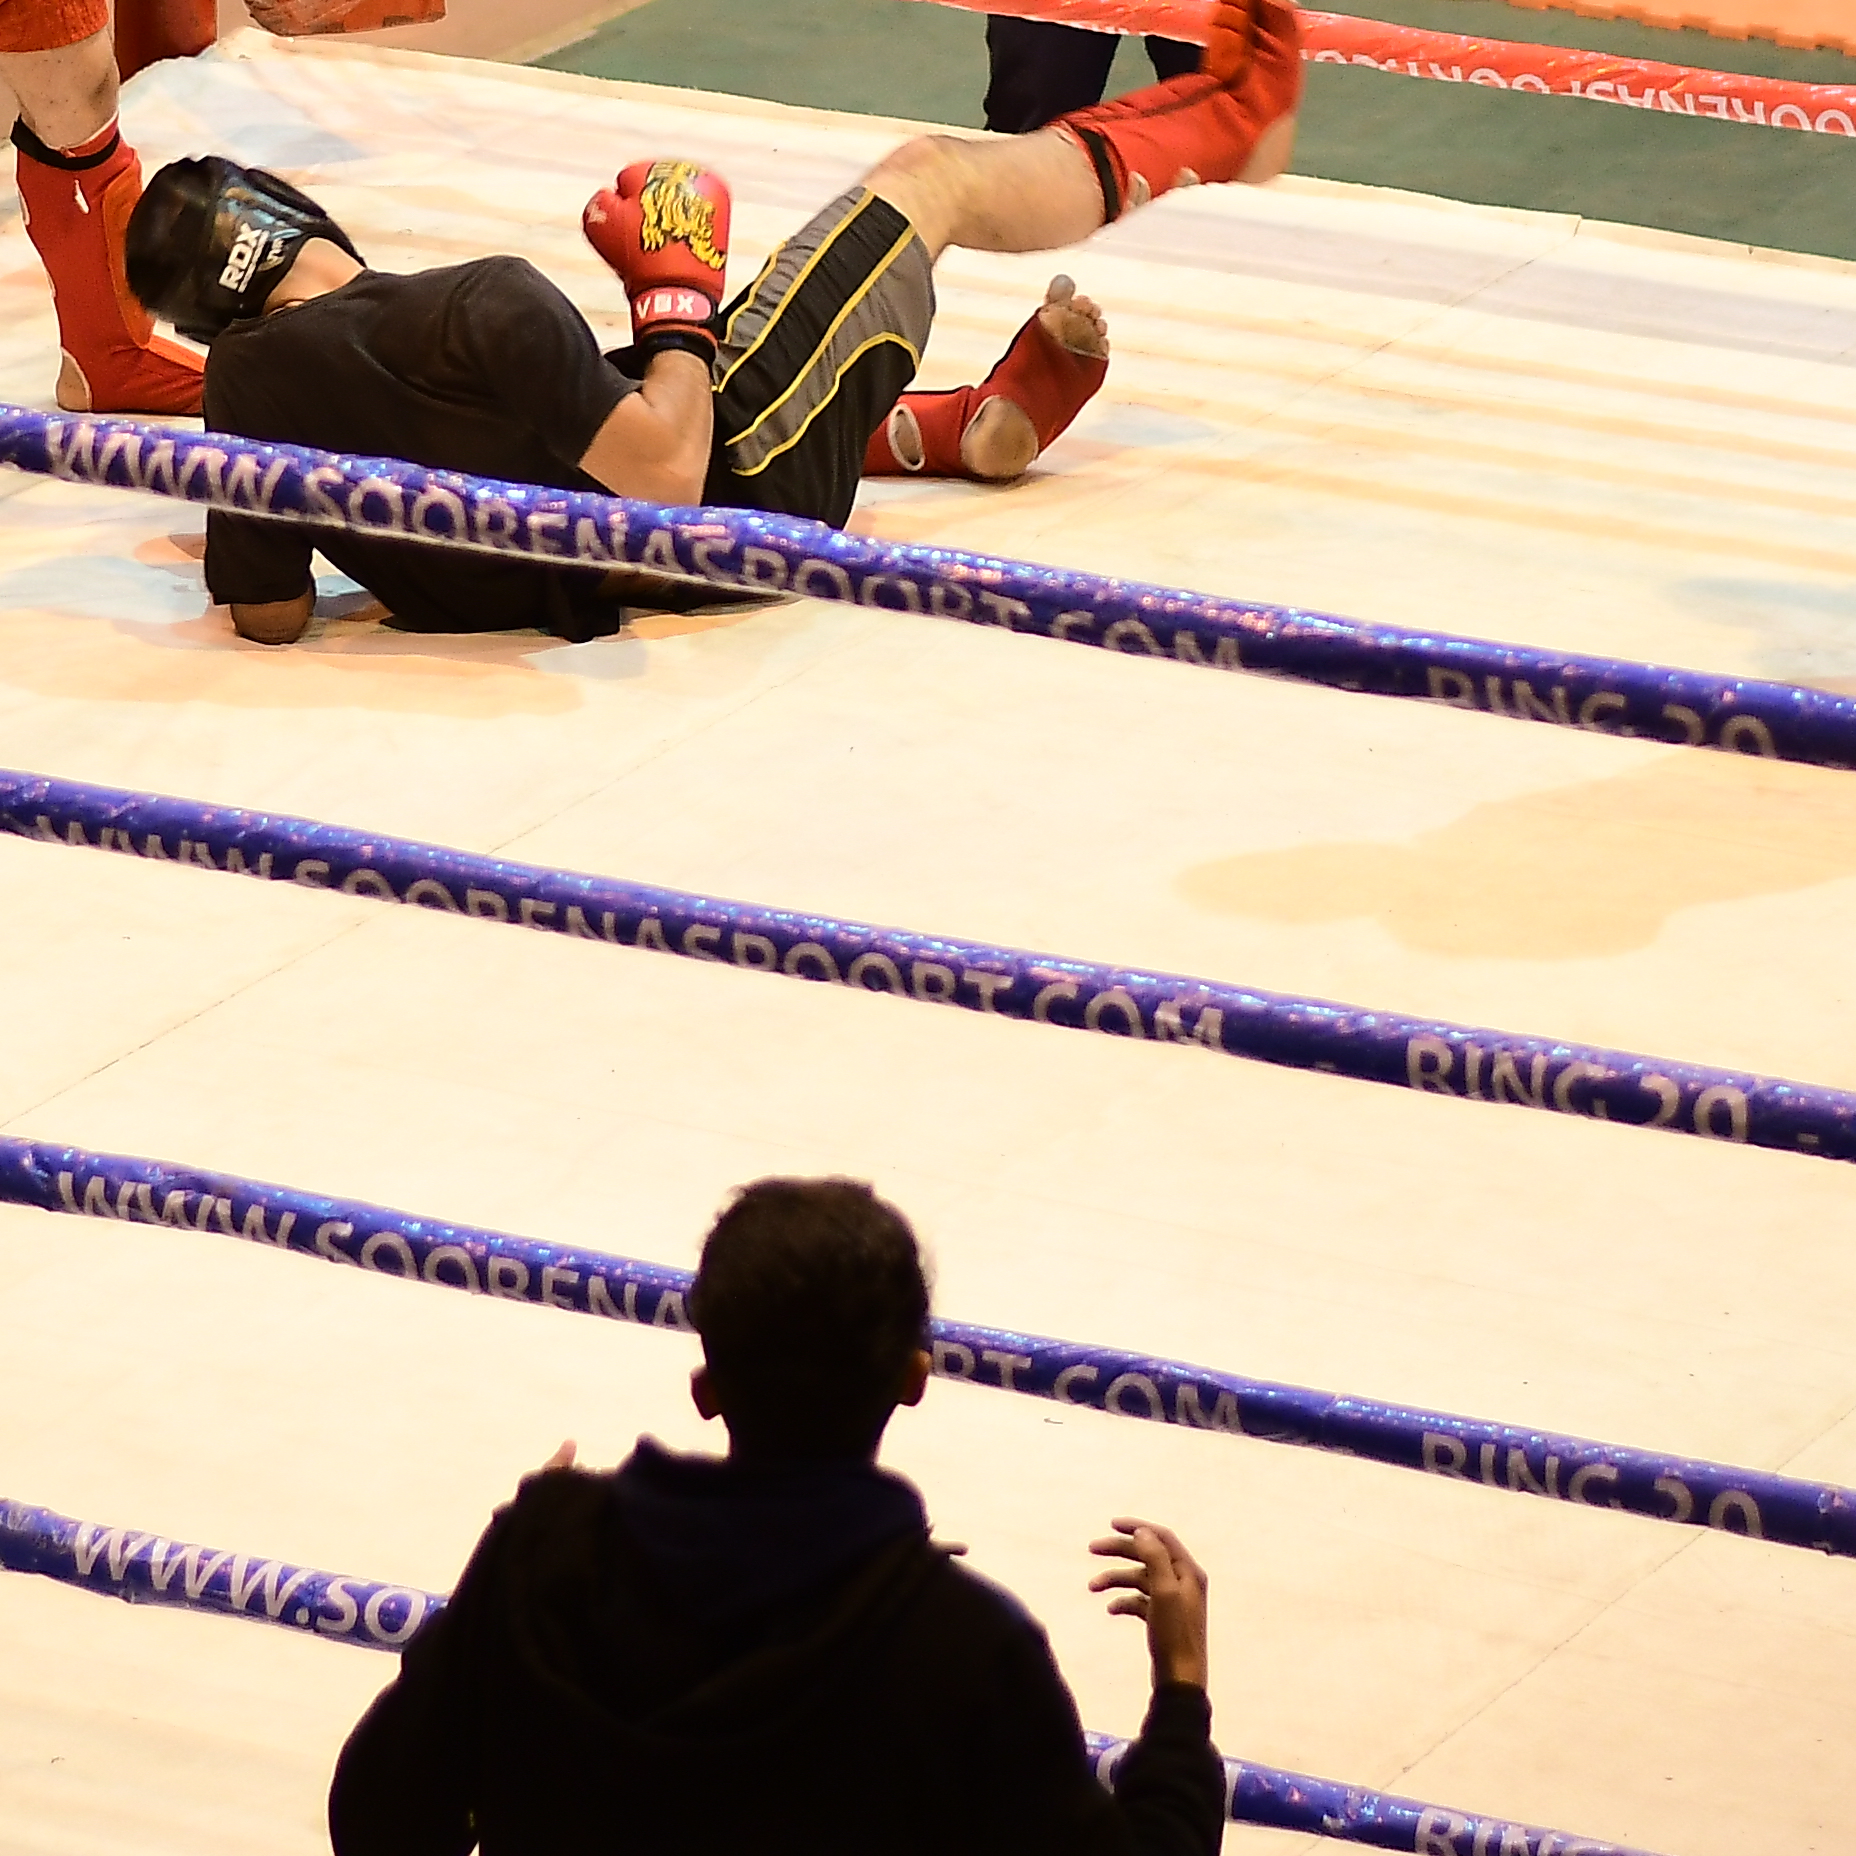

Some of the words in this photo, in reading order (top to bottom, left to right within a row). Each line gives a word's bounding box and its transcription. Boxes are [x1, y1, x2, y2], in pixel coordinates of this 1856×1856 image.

[218, 222, 263, 291] RDX
[46, 419, 1246, 674] WWWSOORENASPOORTCOM
[34, 813, 1226, 1055] WWWSOORENASPOORTCOM
